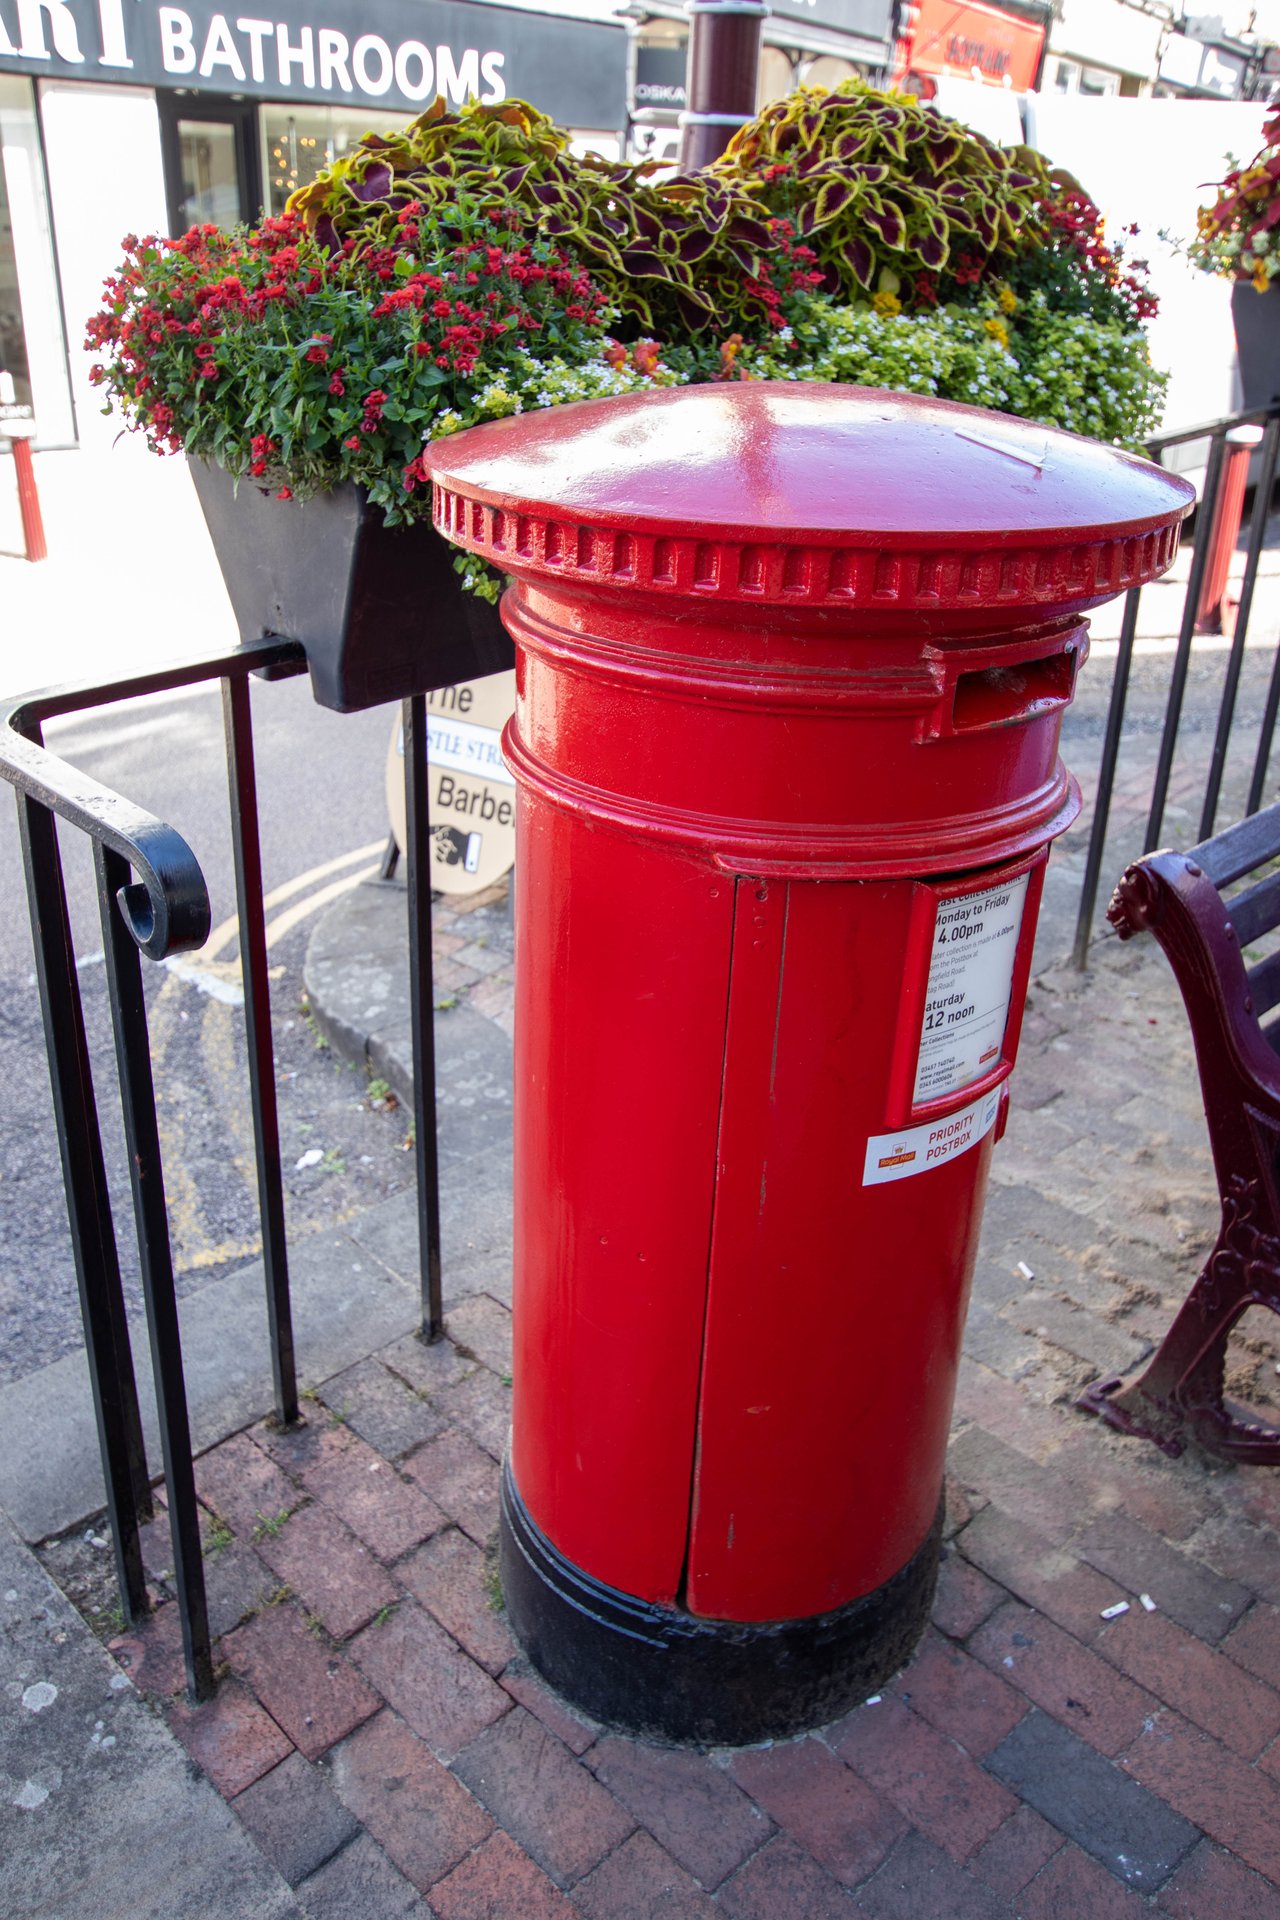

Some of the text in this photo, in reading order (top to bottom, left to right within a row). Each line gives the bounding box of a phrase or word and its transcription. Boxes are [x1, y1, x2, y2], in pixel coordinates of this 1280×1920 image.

[159, 7, 507, 104] BATHROOMS
[635, 84, 687, 102] OSKA
[429, 685, 473, 713] he
[973, 904, 982, 915] to
[984, 894, 1010, 912] Friday
[938, 922, 983, 944] 4.00pm
[946, 943, 972, 957] collection
[996, 925, 1014, 938] 6.00pm
[940, 960, 949, 968] the
[951, 953, 972, 965] Postbox
[925, 992, 965, 1012] aturday
[925, 1005, 975, 1030] 12 noon
[928, 1032, 955, 1045] Collections
[920, 1061, 965, 1081] www.royalmail.com
[929, 1113, 974, 1144] PRIORITY
[926, 1130, 972, 1161] POSTBOX
[880, 1156, 899, 1166] Royal
